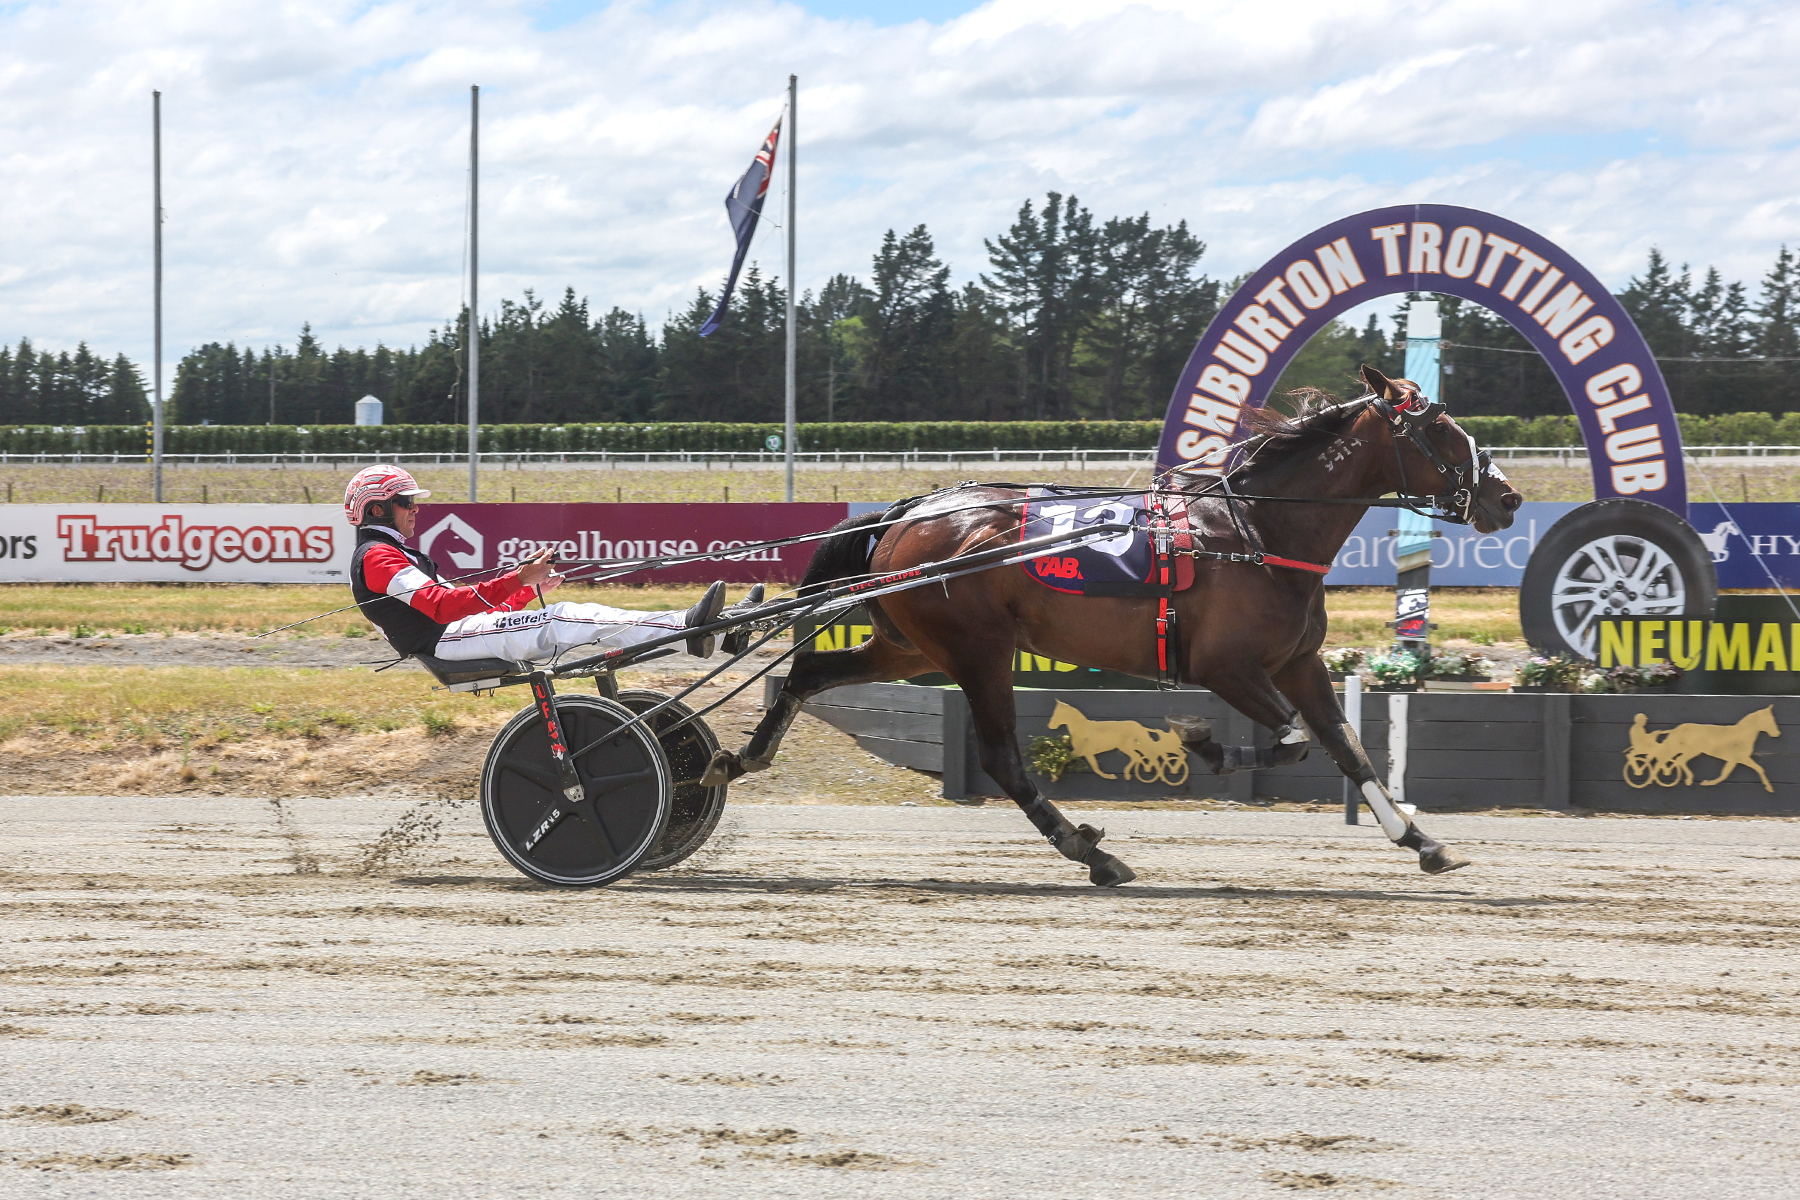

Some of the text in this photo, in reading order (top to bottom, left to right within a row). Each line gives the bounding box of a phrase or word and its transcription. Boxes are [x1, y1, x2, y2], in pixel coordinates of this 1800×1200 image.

[1371, 221, 1616, 366] TROTTING
[1585, 362, 1668, 495] CLUB
[58, 515, 333, 571] Trudgeons
[1032, 556, 1080, 578] TAB
